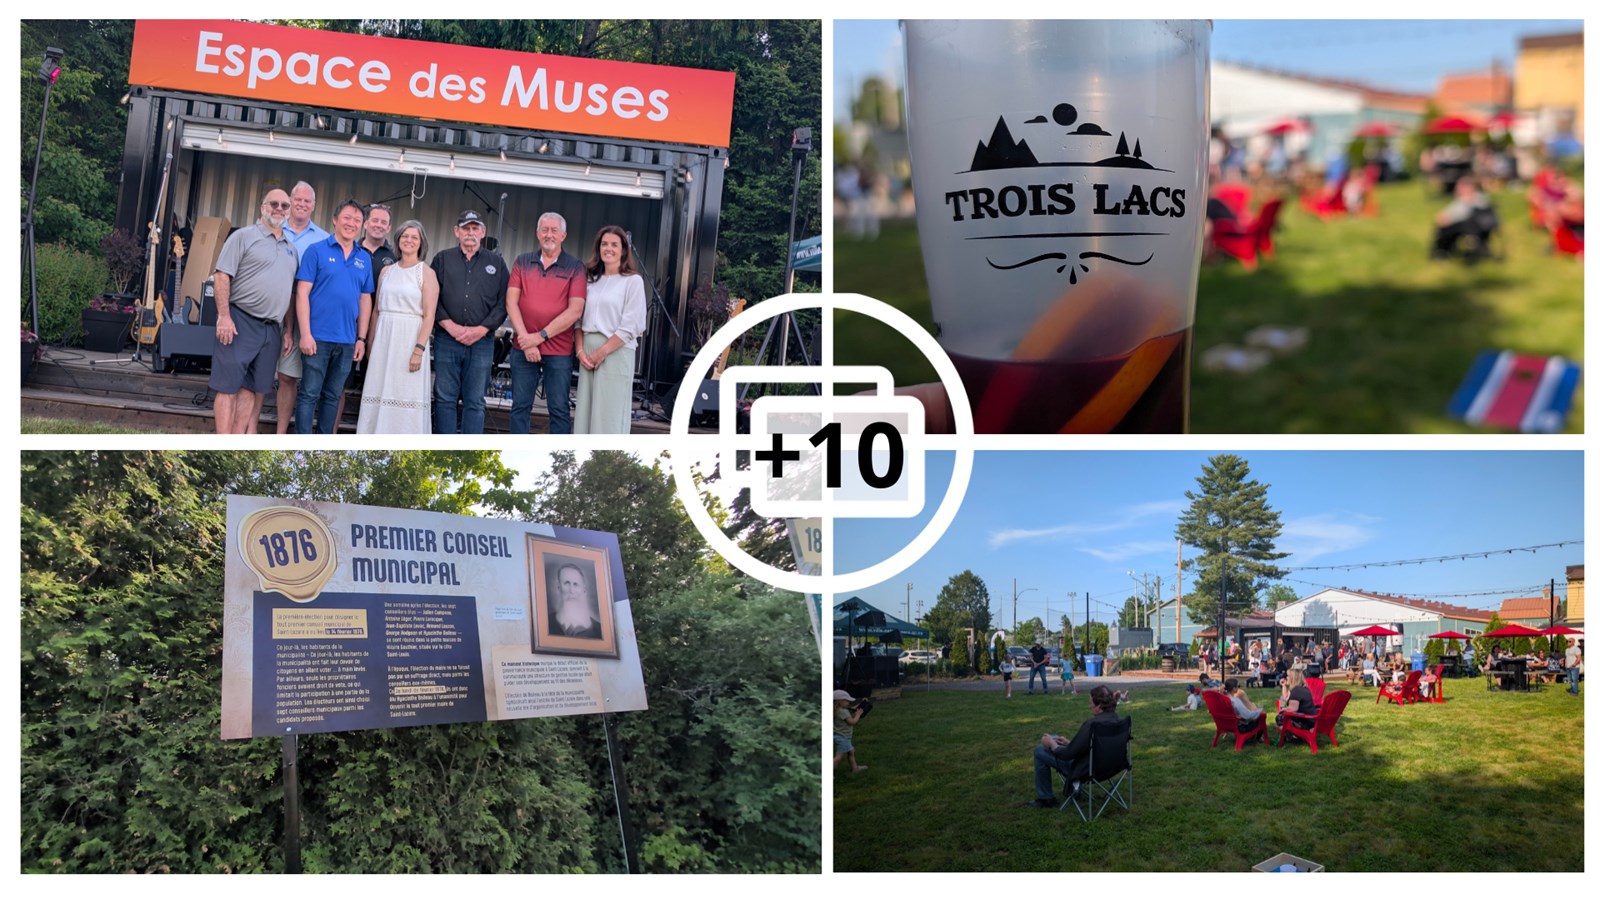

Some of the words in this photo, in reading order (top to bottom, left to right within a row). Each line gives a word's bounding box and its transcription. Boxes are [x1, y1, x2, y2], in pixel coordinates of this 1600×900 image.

[195, 31, 391, 94] Espace
[409, 63, 486, 104] des
[500, 65, 670, 122] Muses
[945, 182, 1076, 221] TROIS
[1093, 183, 1186, 218] LACS
[259, 528, 317, 568] 1876
[351, 523, 437, 553] PREMIER
[443, 531, 512, 558] CONSEIL
[352, 557, 461, 585] MUNICIPAL
